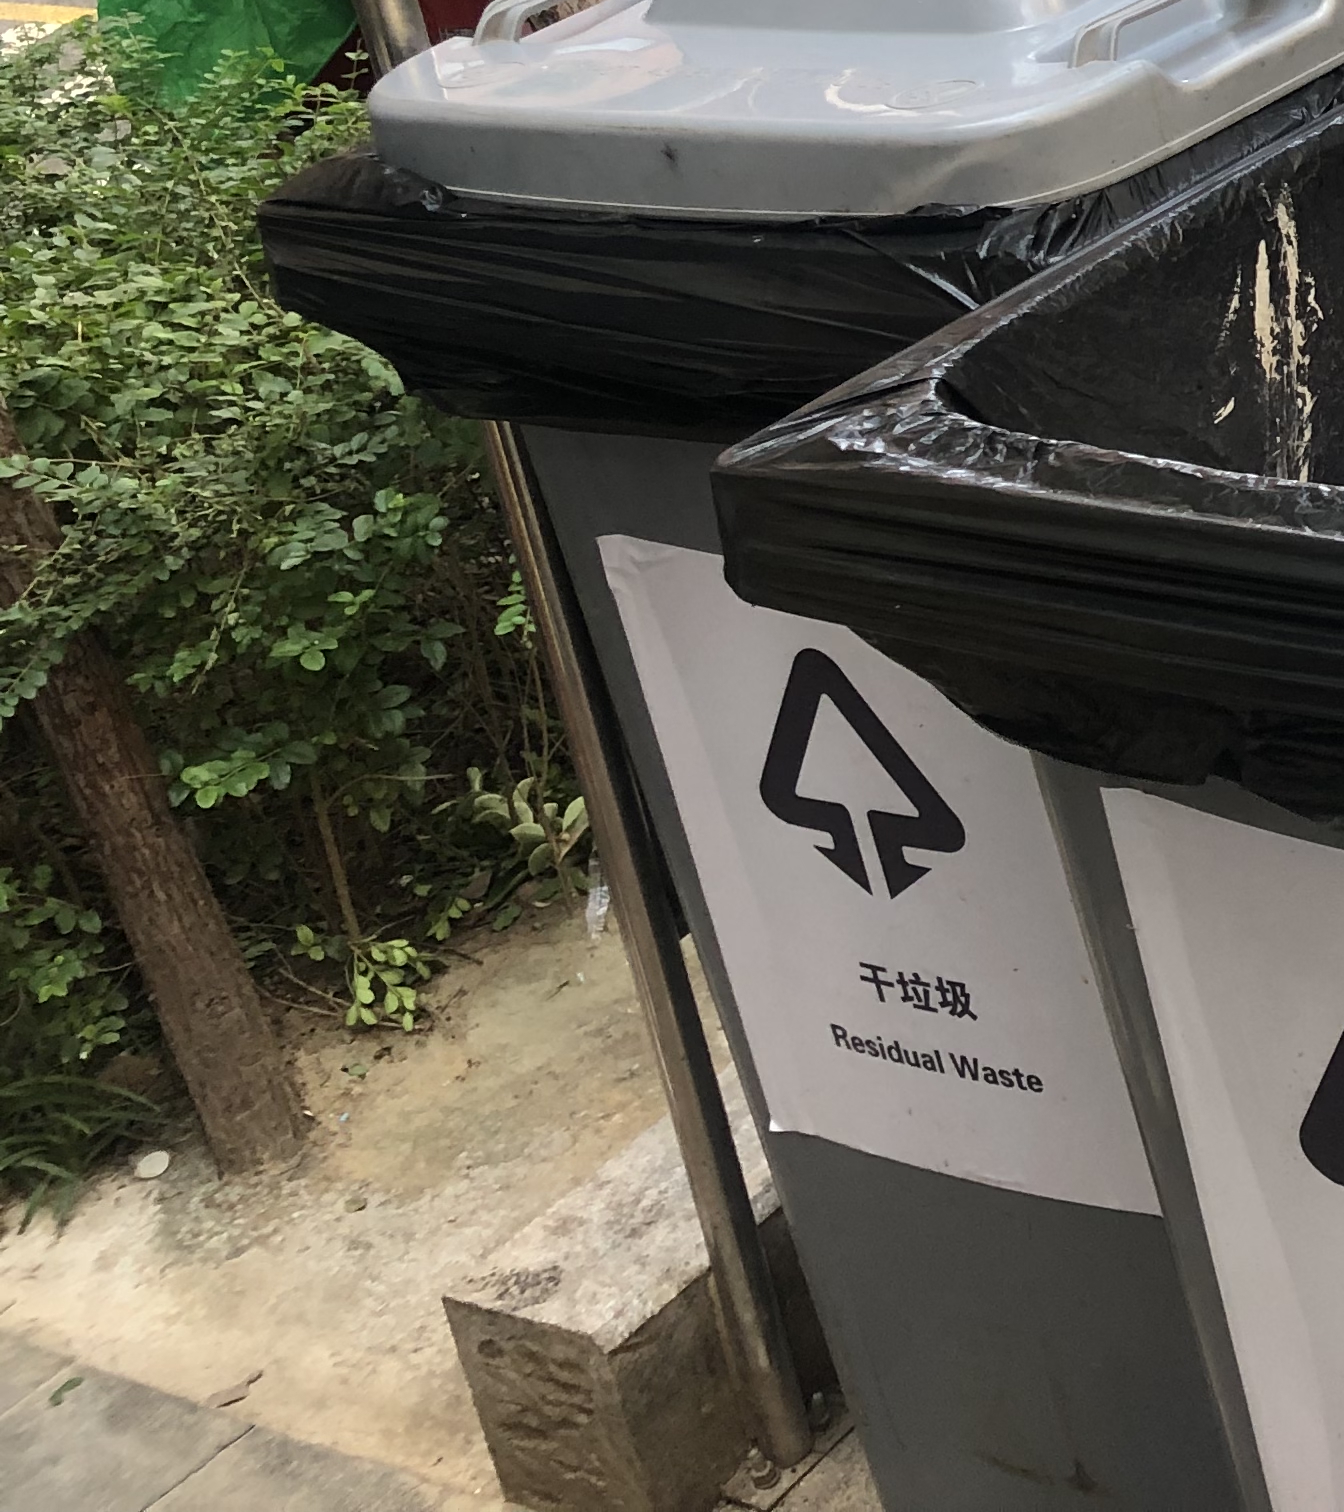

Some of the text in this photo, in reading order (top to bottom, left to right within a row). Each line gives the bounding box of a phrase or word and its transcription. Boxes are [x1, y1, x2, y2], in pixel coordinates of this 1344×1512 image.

[858, 961, 978, 1021] 干垃圾
[830, 1023, 1044, 1093] Residual Waste
